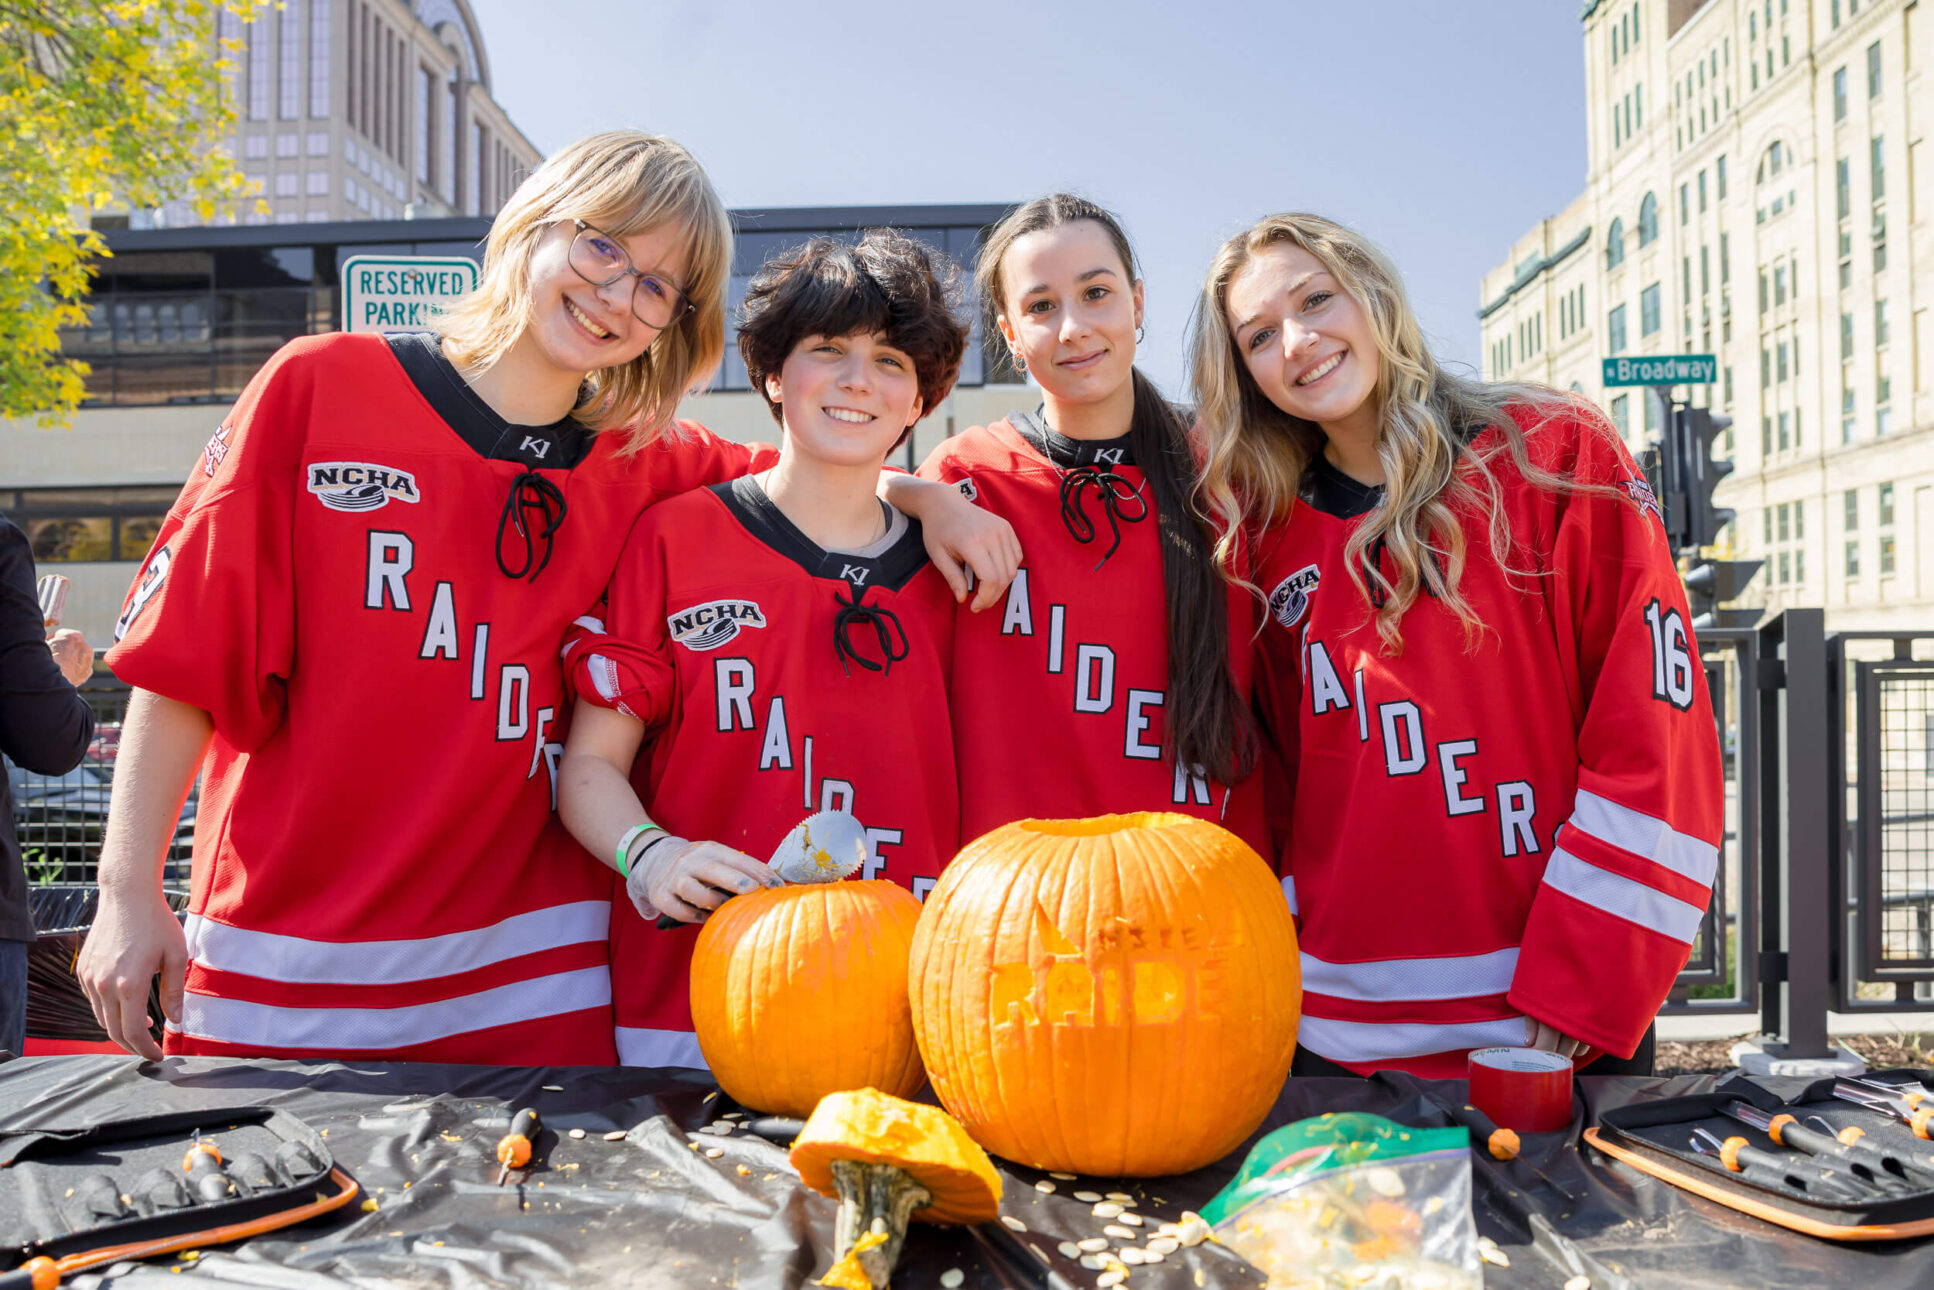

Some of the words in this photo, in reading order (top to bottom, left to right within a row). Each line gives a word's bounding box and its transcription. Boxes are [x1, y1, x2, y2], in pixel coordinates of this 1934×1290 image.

[361, 270, 463, 296] RESERVED
[365, 301, 449, 326] PARKI
[1618, 358, 1713, 383] Broadway
[313, 466, 416, 497] NCHA
[1270, 569, 1320, 611] NCHA
[672, 603, 764, 636] NCHA
[1643, 596, 1693, 713] 16
